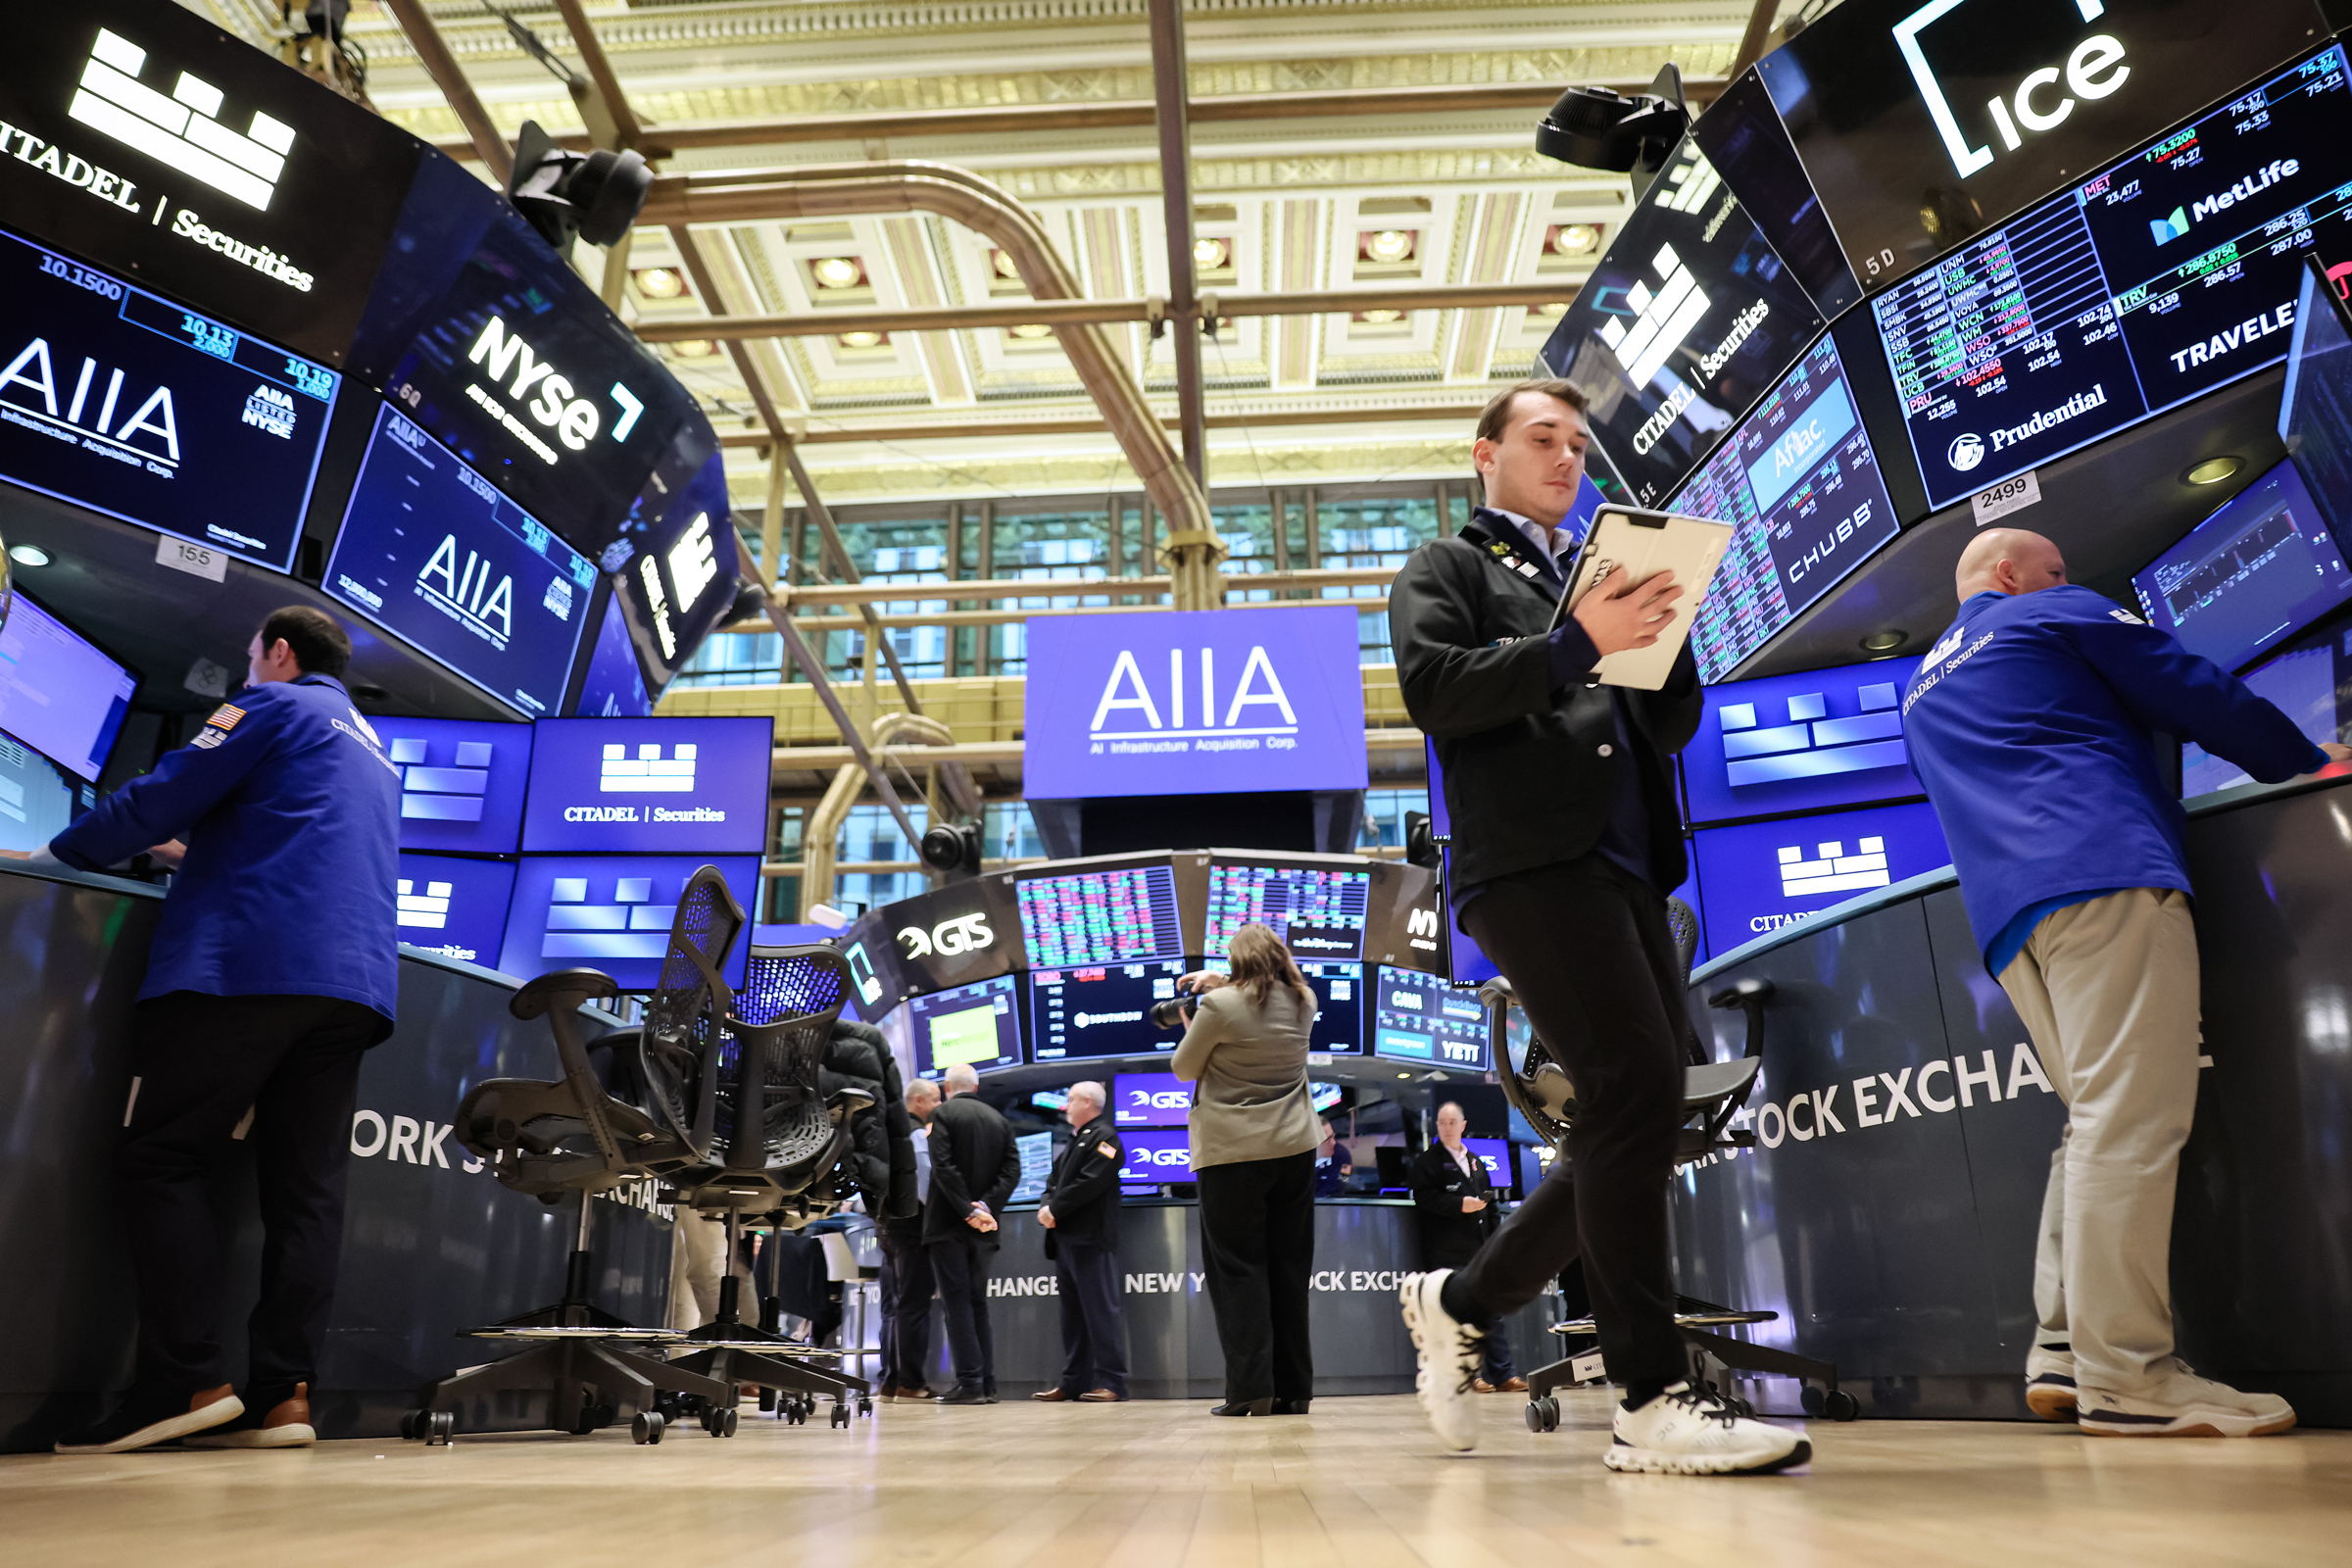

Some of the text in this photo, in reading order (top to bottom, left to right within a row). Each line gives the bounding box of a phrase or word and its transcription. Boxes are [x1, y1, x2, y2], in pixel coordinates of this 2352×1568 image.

[2298, 50, 2334, 79] 75.37
[2305, 71, 2344, 98] 75.21
[2229, 90, 2262, 118] 75.17
[2248, 99, 2266, 115] 200
[2234, 110, 2270, 136] 75.33
[2152, 128, 2196, 159] 75.3200
[2170, 146, 2201, 171] 75.27
[2084, 174, 2111, 197] MET
[2105, 178, 2140, 206] 23,477
[2192, 158, 2300, 222] MetLife
[2264, 208, 2307, 237] 286.25
[172, 209, 316, 292] Securities
[2270, 227, 2313, 257] 287.00
[1940, 254, 1965, 273] UNM
[2184, 242, 2237, 275] 286.8750
[39, 254, 122, 302] 10.1500
[1944, 267, 1966, 285] USB
[1947, 274, 1977, 296] UWMC
[2203, 261, 2242, 288] 286.57
[1877, 289, 1900, 309] RYAN
[2120, 284, 2147, 307] TRV
[2148, 291, 2180, 315] 9,139
[1954, 301, 1979, 318] VOYA
[1958, 311, 1984, 331] WCN
[2077, 303, 2112, 328] 102.74
[2099, 312, 2114, 324] 200
[180, 315, 234, 348] 10.13
[1887, 323, 1907, 342] SNV
[1961, 325, 1983, 342] WM
[2023, 330, 2054, 355] 102.17
[2082, 320, 2118, 346] 102.46
[2170, 298, 2299, 373] TRAVELE
[1890, 336, 1910, 353] SSB
[1893, 347, 1913, 364] TFC
[1965, 335, 1991, 354] WSO
[2043, 339, 2057, 352] 100
[1896, 359, 1916, 375] TFIN
[1961, 358, 2002, 385] 102.4550
[2028, 349, 2061, 372] 102.54
[284, 358, 333, 389] 10.19
[1633, 380, 1697, 456] CITADEL
[1699, 297, 1771, 380] Securities
[1899, 369, 1920, 387] TRV
[1975, 374, 2007, 398] 102.54
[0, 337, 181, 462] AIIA
[253, 384, 295, 412] AIIA
[1903, 381, 1925, 399] UCB
[1909, 391, 1933, 412] PRU
[246, 398, 297, 423] LISTED
[1926, 399, 1957, 421] 12,255
[1989, 382, 2107, 453] Prudential
[241, 408, 294, 440] NYSE
[82, 438, 143, 467] Acquisition
[1775, 418, 1825, 478] Aflac
[1793, 438, 1827, 474] Incorporated
[457, 466, 497, 505] 10.1500
[1981, 478, 2027, 509] 2499
[1765, 518, 1775, 532] CB
[178, 544, 211, 565] 155
[1788, 500, 1873, 584] CHUBB
[418, 533, 513, 637] AIIA
[543, 596, 570, 622] NYSE
[1902, 630, 1994, 716] CITADEL Securities
[1090, 645, 1298, 732] AIIA
[1090, 735, 1298, 756] AI Infrastructure Acquisition Corp.
[564, 806, 726, 823] CITADEL Securities
[932, 911, 994, 956] GTS
[1749, 910, 1820, 933] CITA
[1392, 990, 1423, 1010] CAVA
[1441, 1040, 1481, 1063] YETI
[1852, 1042, 2055, 1128] EXCHA
[1151, 1091, 1191, 1109] GTS
[349, 1108, 454, 1170] ORK
[1152, 1148, 1192, 1166] GTS
[986, 1276, 1060, 1298] HANGE
[1124, 1272, 1185, 1294] NEW
[1350, 1271, 1407, 1292] EXCH
